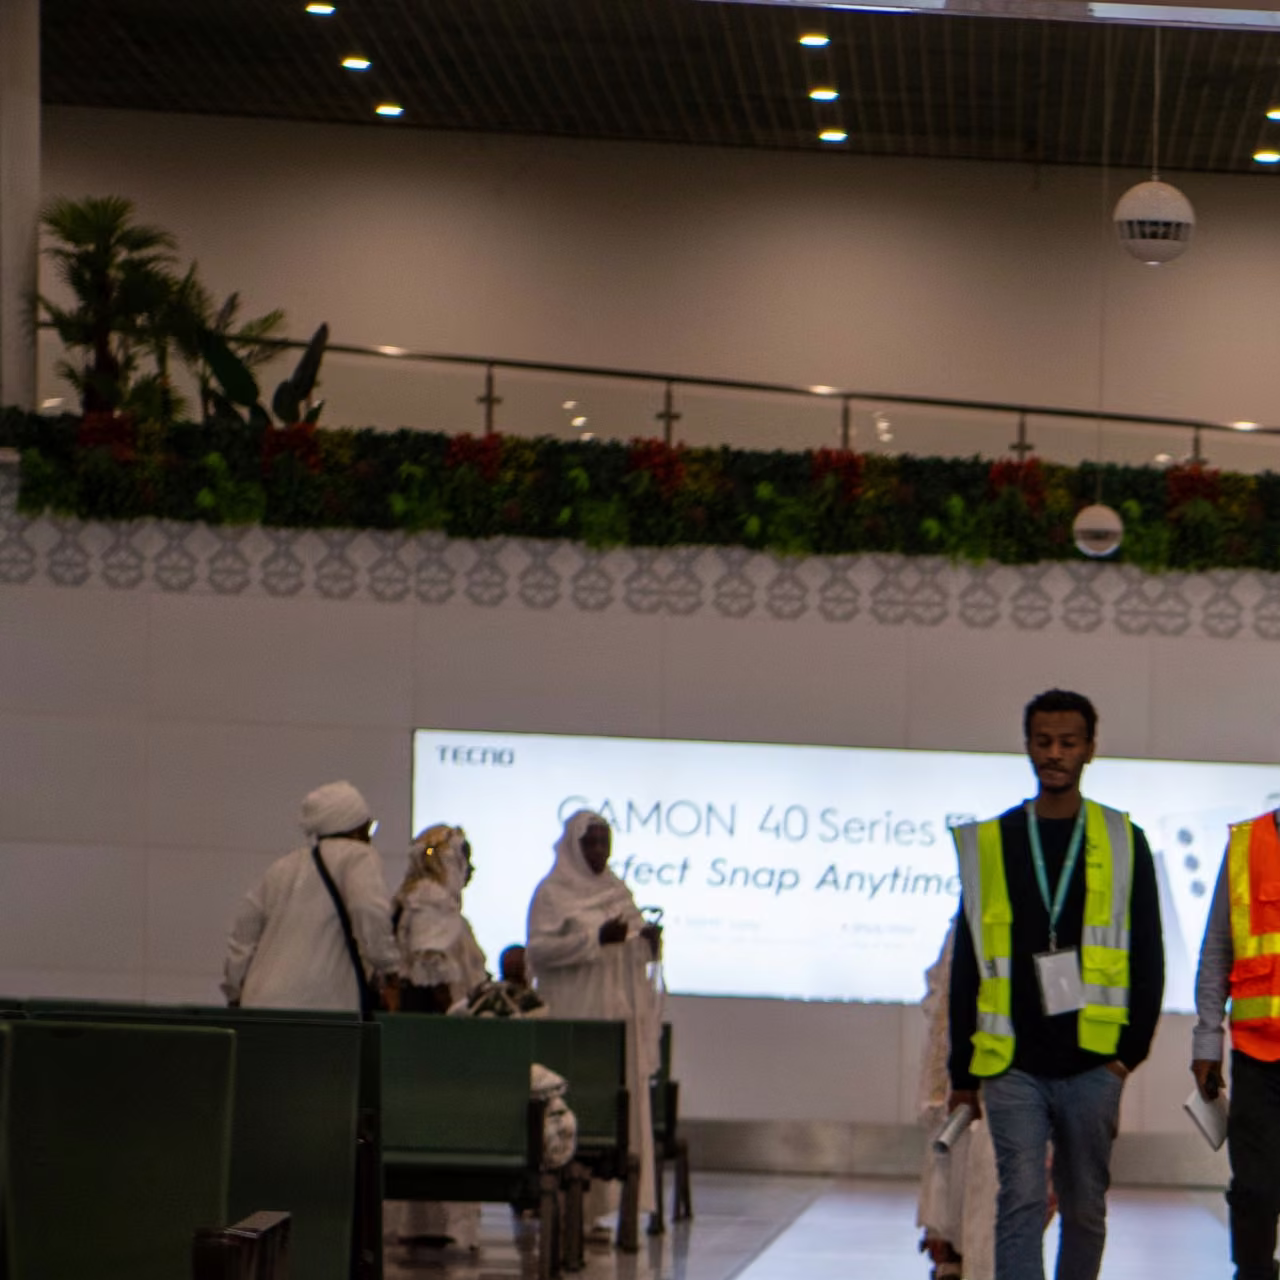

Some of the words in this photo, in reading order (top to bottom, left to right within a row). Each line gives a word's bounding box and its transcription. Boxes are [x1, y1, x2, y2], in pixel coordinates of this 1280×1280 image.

[435, 745, 515, 767] TECNO
[758, 804, 808, 842] 40
[818, 807, 937, 846] Series
[706, 857, 800, 895] Snap
